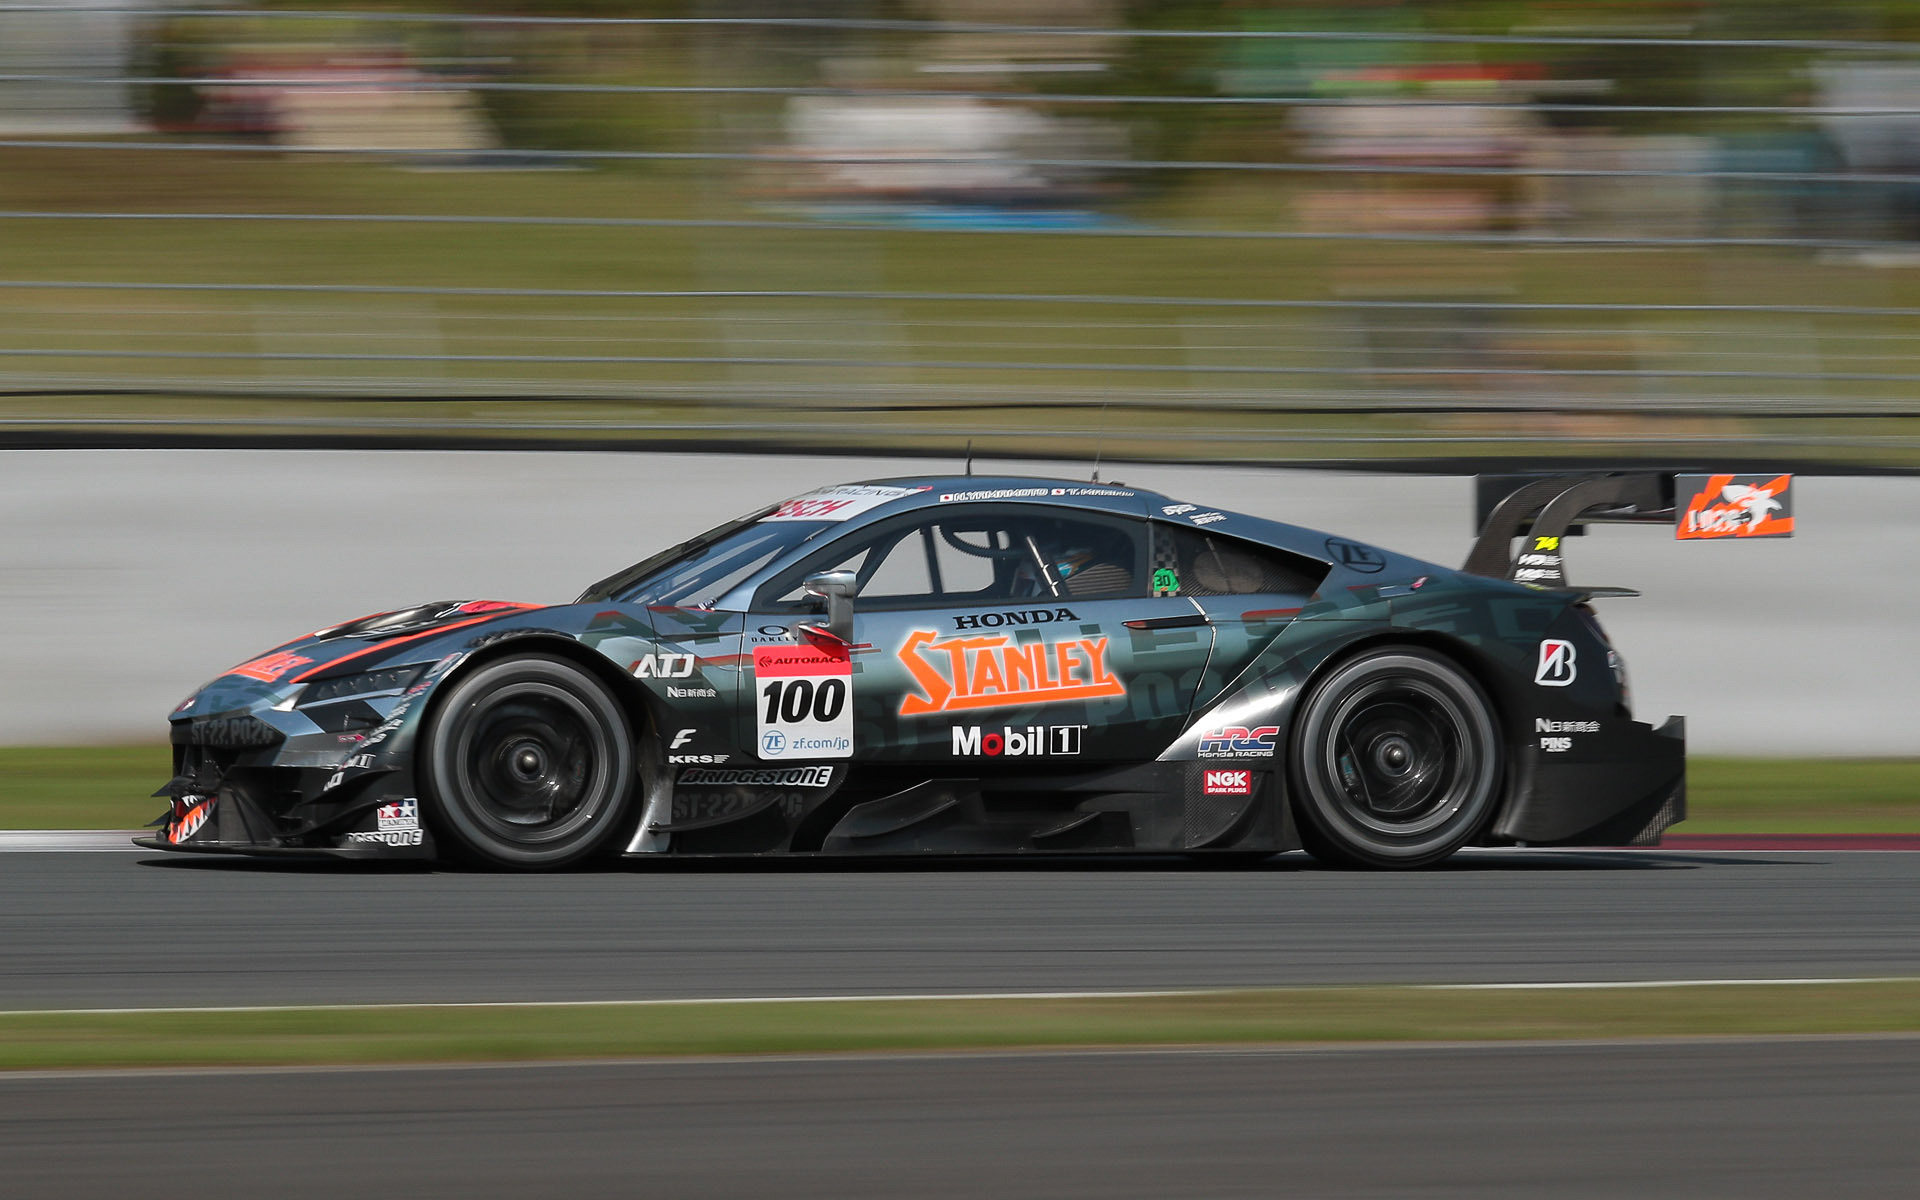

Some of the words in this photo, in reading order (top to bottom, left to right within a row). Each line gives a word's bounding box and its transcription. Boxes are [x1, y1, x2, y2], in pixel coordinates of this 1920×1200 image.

[1154, 574, 1171, 587] 30
[953, 608, 1080, 630] HONDA
[774, 656, 845, 665] AUTOBACS
[898, 631, 1126, 716] STANLEY
[763, 678, 846, 724] 100
[793, 736, 850, 750] zf.com/jp
[952, 725, 1044, 756] Mobil
[1197, 726, 1280, 752] HRC
[680, 768, 833, 787] BRIDGESTONE
[1207, 771, 1247, 787] NGK
